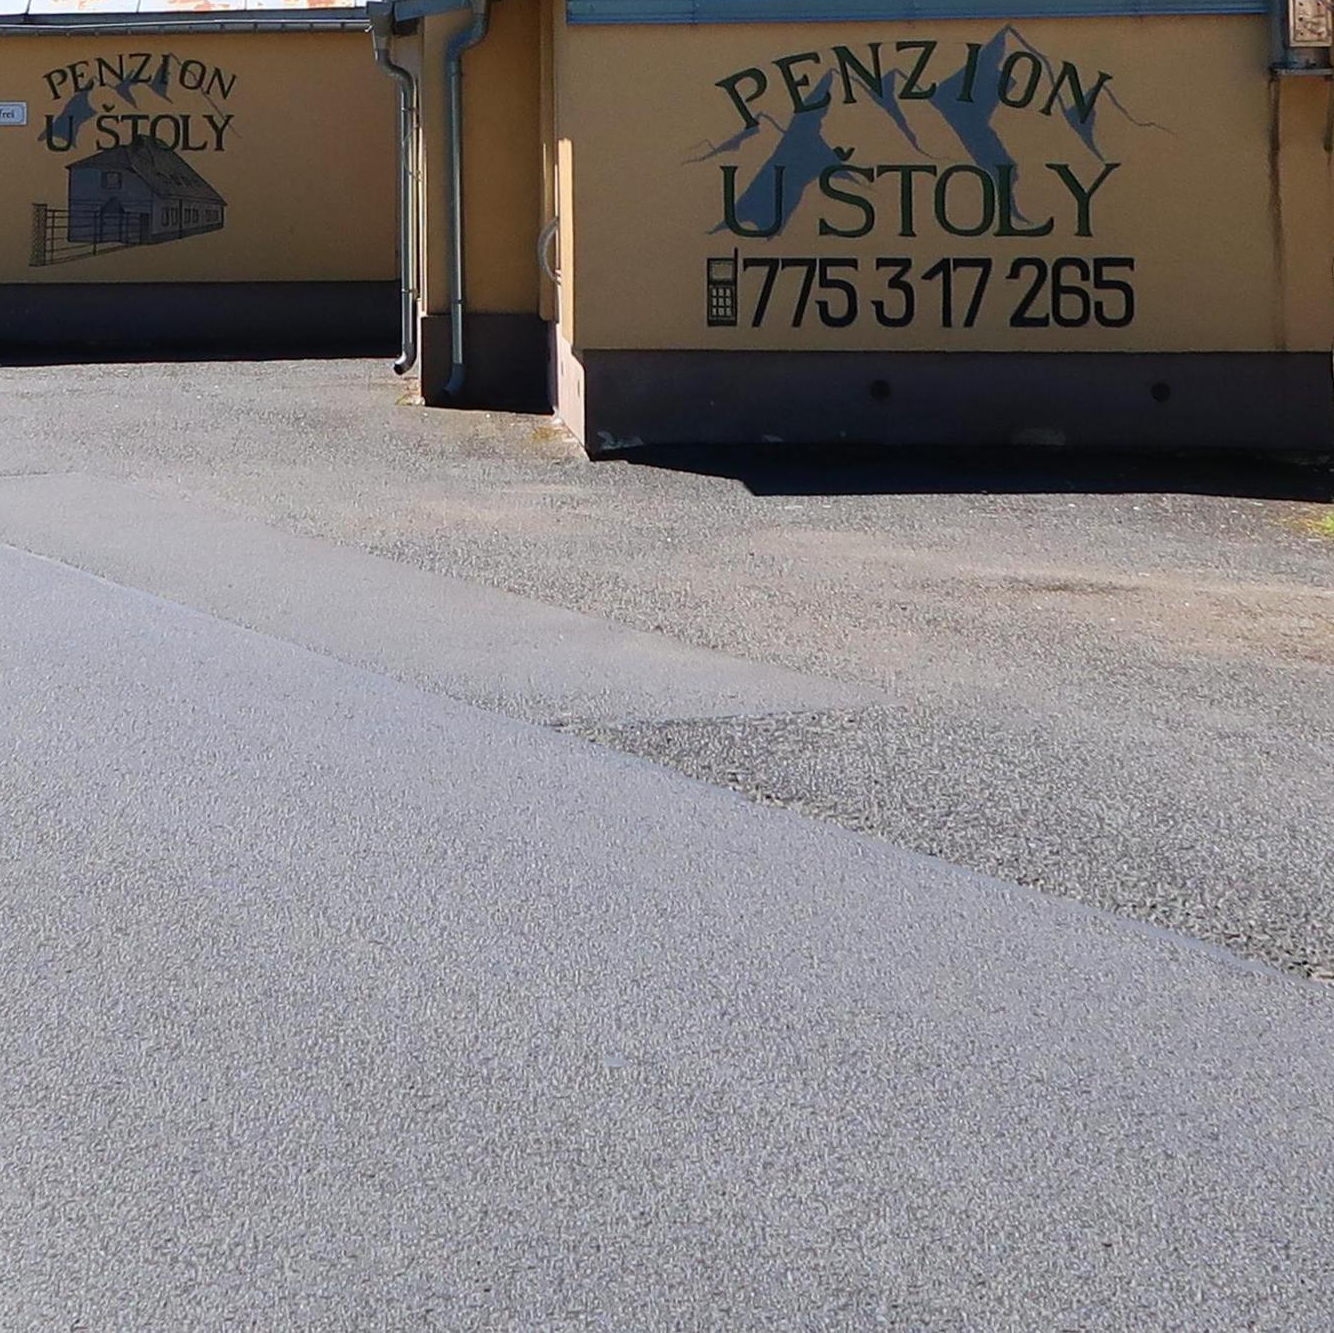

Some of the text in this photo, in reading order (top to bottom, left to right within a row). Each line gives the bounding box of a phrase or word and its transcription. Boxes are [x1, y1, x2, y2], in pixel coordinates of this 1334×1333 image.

[42, 52, 237, 100] PENZION
[715, 40, 1113, 129] PENZION
[44, 103, 235, 153] U ŠTOLY
[719, 147, 1122, 238] U ŠTOLY
[743, 257, 1135, 328] 775 317 265
